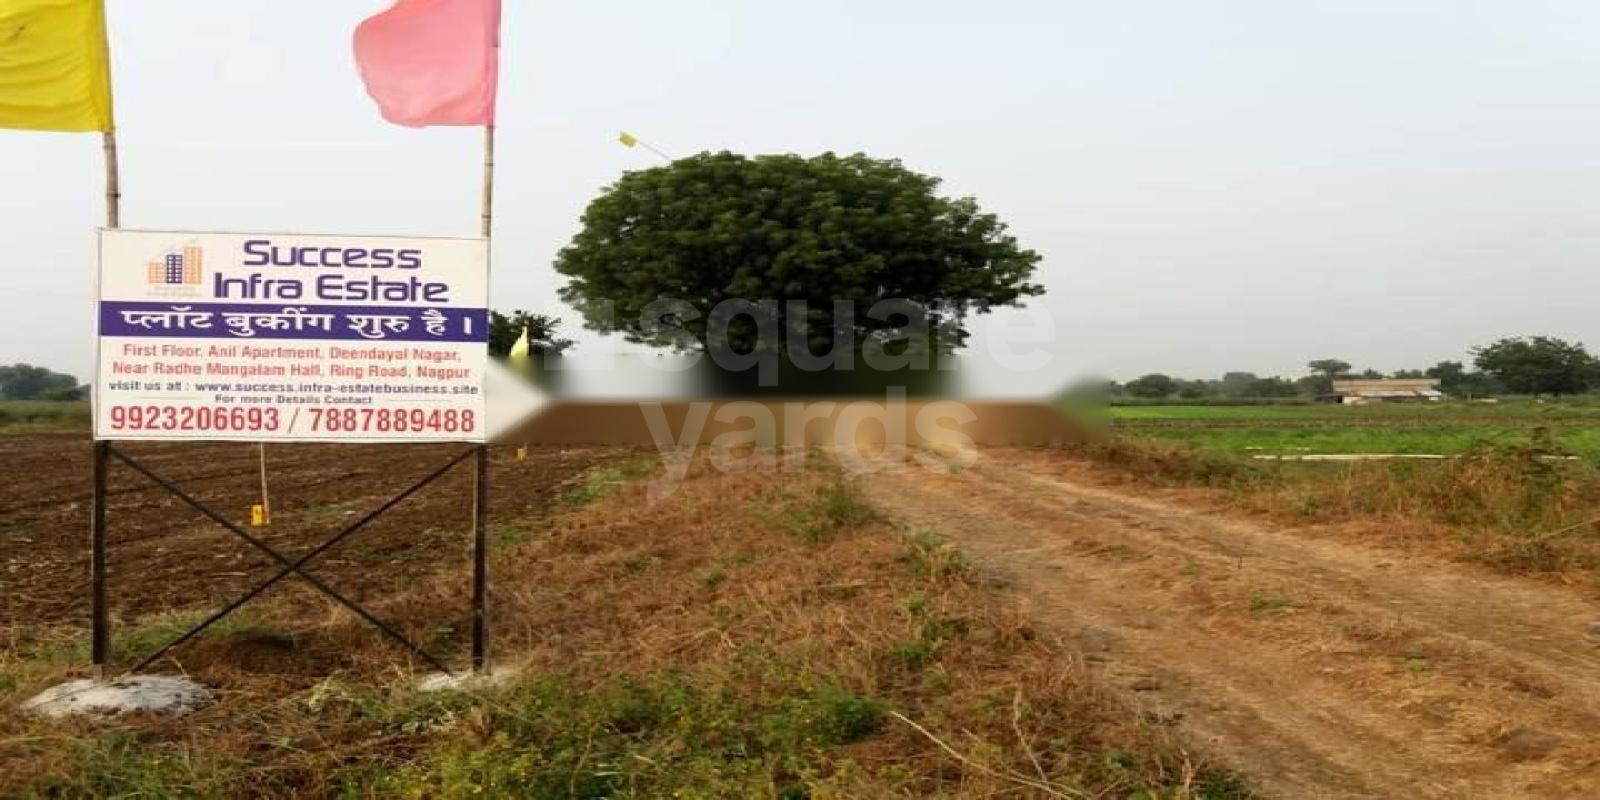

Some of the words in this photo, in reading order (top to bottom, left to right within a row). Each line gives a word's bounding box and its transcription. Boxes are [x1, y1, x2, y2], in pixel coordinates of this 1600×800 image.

[242, 240, 422, 269] Success
[213, 272, 303, 299] Infra
[316, 273, 449, 302] Estate
[120, 304, 214, 330] प्लॉट
[421, 308, 449, 336] है
[123, 344, 157, 356] First
[162, 345, 202, 358] Floor,
[208, 345, 236, 357] Anil
[242, 345, 324, 360] Apartment,
[330, 347, 408, 362] Deendayal
[413, 349, 462, 363] Nagar,
[112, 361, 149, 374] Near
[153, 361, 201, 375] Radhe
[206, 362, 286, 377] Mangalam
[291, 364, 325, 377] Hall,
[330, 364, 363, 379] Ring
[368, 365, 412, 378] Road,
[417, 366, 471, 380] Nagpur
[109, 380, 139, 391] visit
[144, 382, 161, 391] us
[166, 381, 182, 391] at
[215, 394, 235, 404] For
[240, 395, 271, 404] more
[277, 395, 320, 404] Details
[324, 395, 372, 404] Contact
[110, 405, 279, 431] 9923206693
[308, 408, 475, 432] 7887889488
